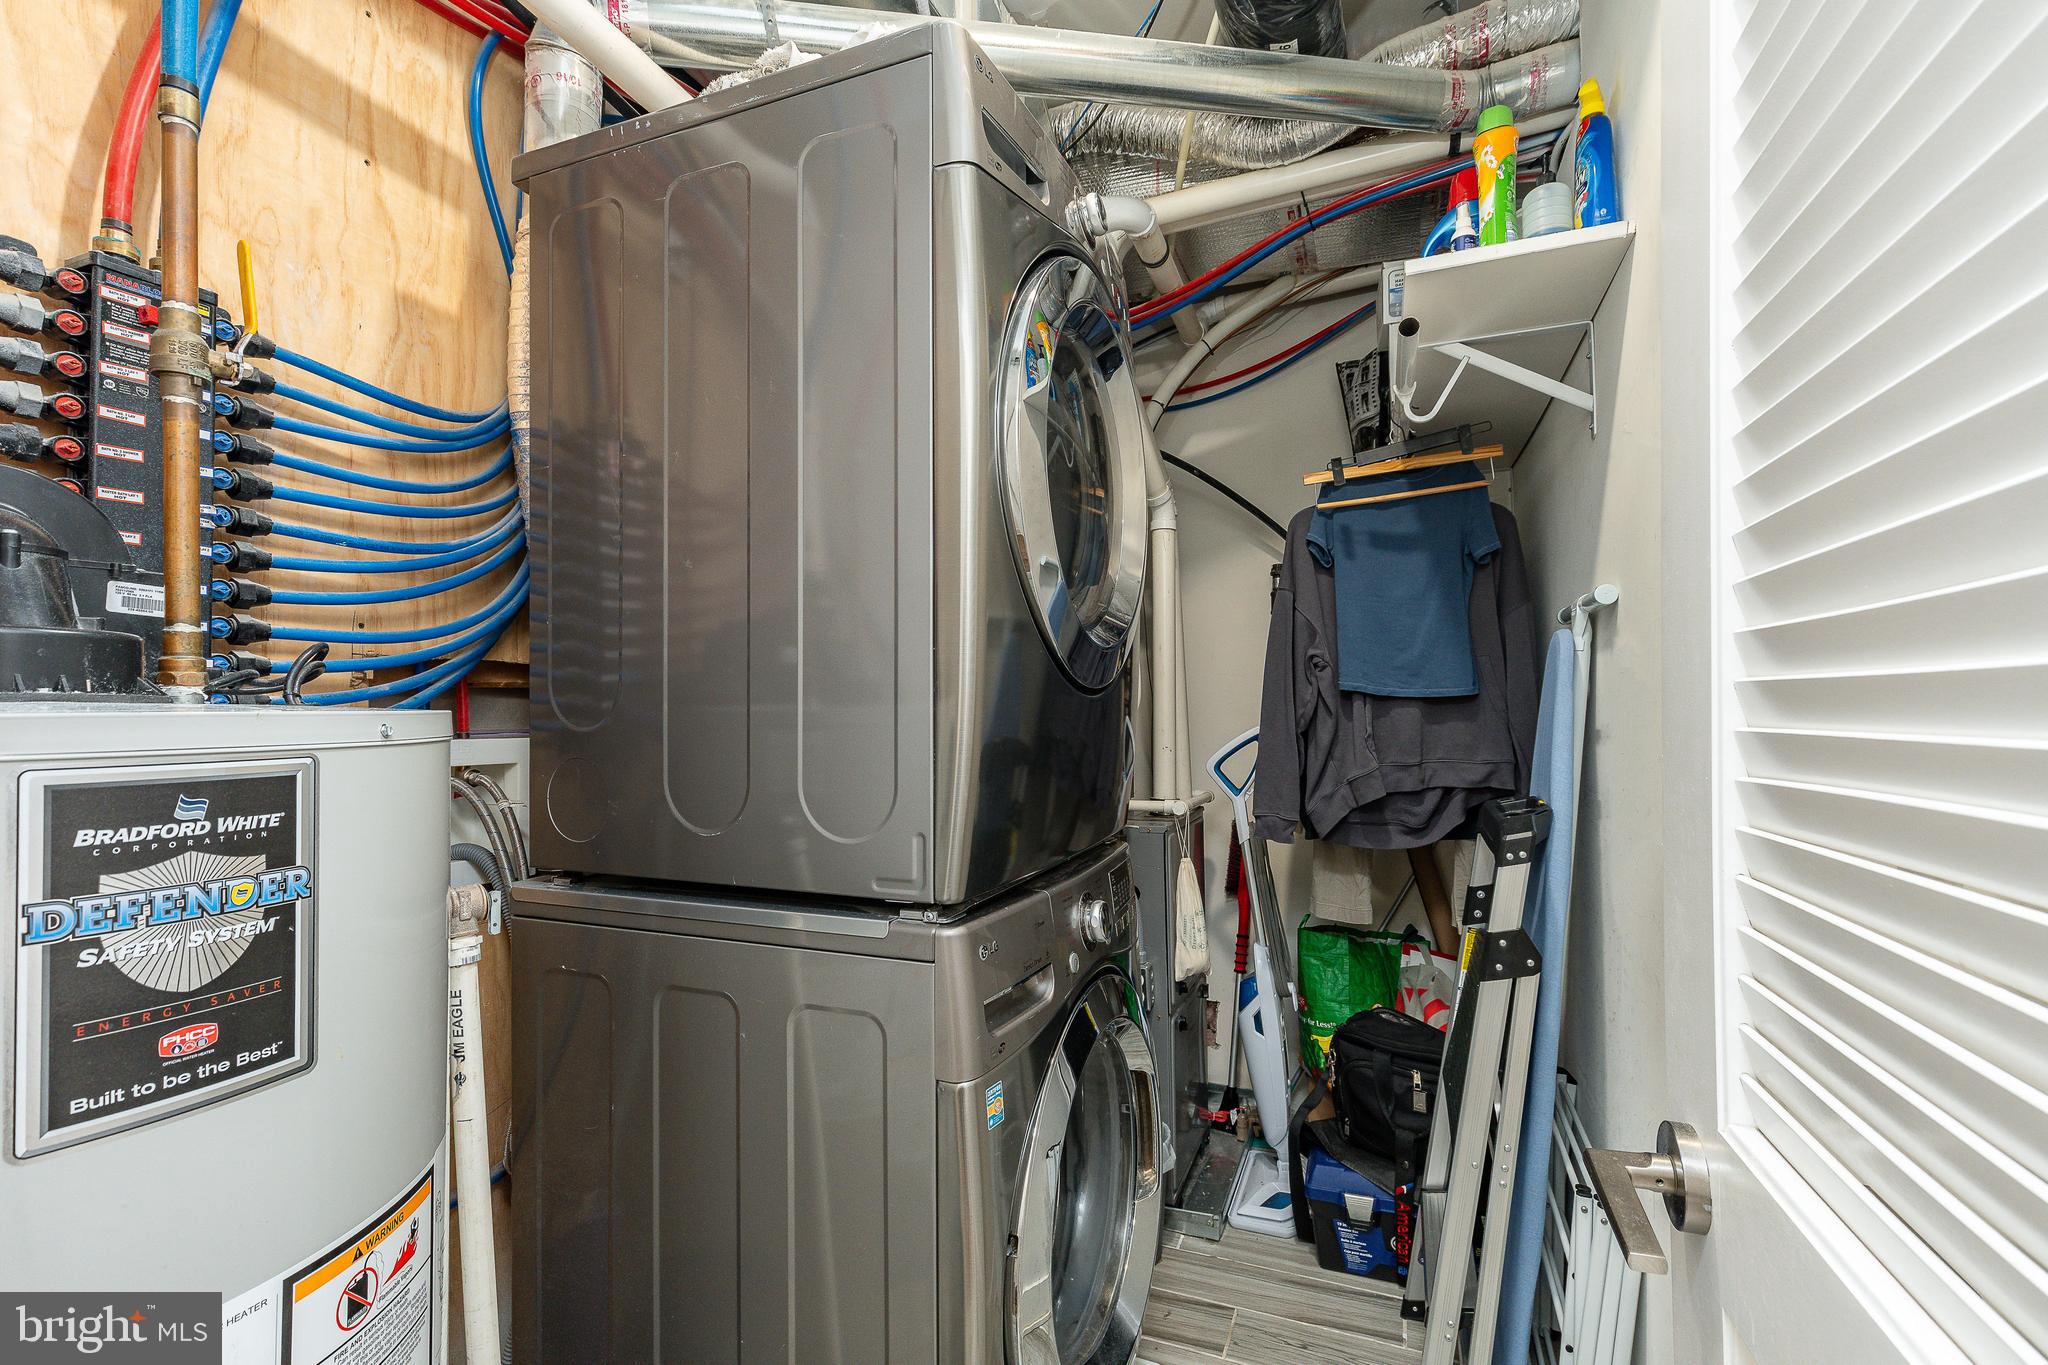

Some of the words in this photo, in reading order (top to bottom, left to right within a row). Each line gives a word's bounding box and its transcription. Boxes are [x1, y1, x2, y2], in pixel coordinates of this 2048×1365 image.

[73, 820, 211, 848] BRADFORD
[92, 830, 268, 857] CORPORATION
[22, 866, 312, 946] DEFENDER
[76, 933, 184, 968] SAFETY
[186, 919, 275, 948] SYSTEM
[76, 1002, 192, 1037] ENERGY
[210, 979, 282, 1006] SAVER
[450, 989, 465, 1038] EAGLE
[162, 1024, 217, 1048] PHCC
[70, 1088, 126, 1114] Built
[131, 1080, 156, 1098] to
[162, 1070, 191, 1090] be
[196, 1057, 231, 1080] the
[236, 1043, 279, 1067] Best
[365, 1211, 405, 1250] WARNING
[1397, 1200, 1411, 1264] American
[226, 1298, 268, 1327] HEATER
[334, 1346, 349, 1363] FIRE
[349, 1333, 363, 1349] AND
[363, 1306, 393, 1338] EXPLOSION
